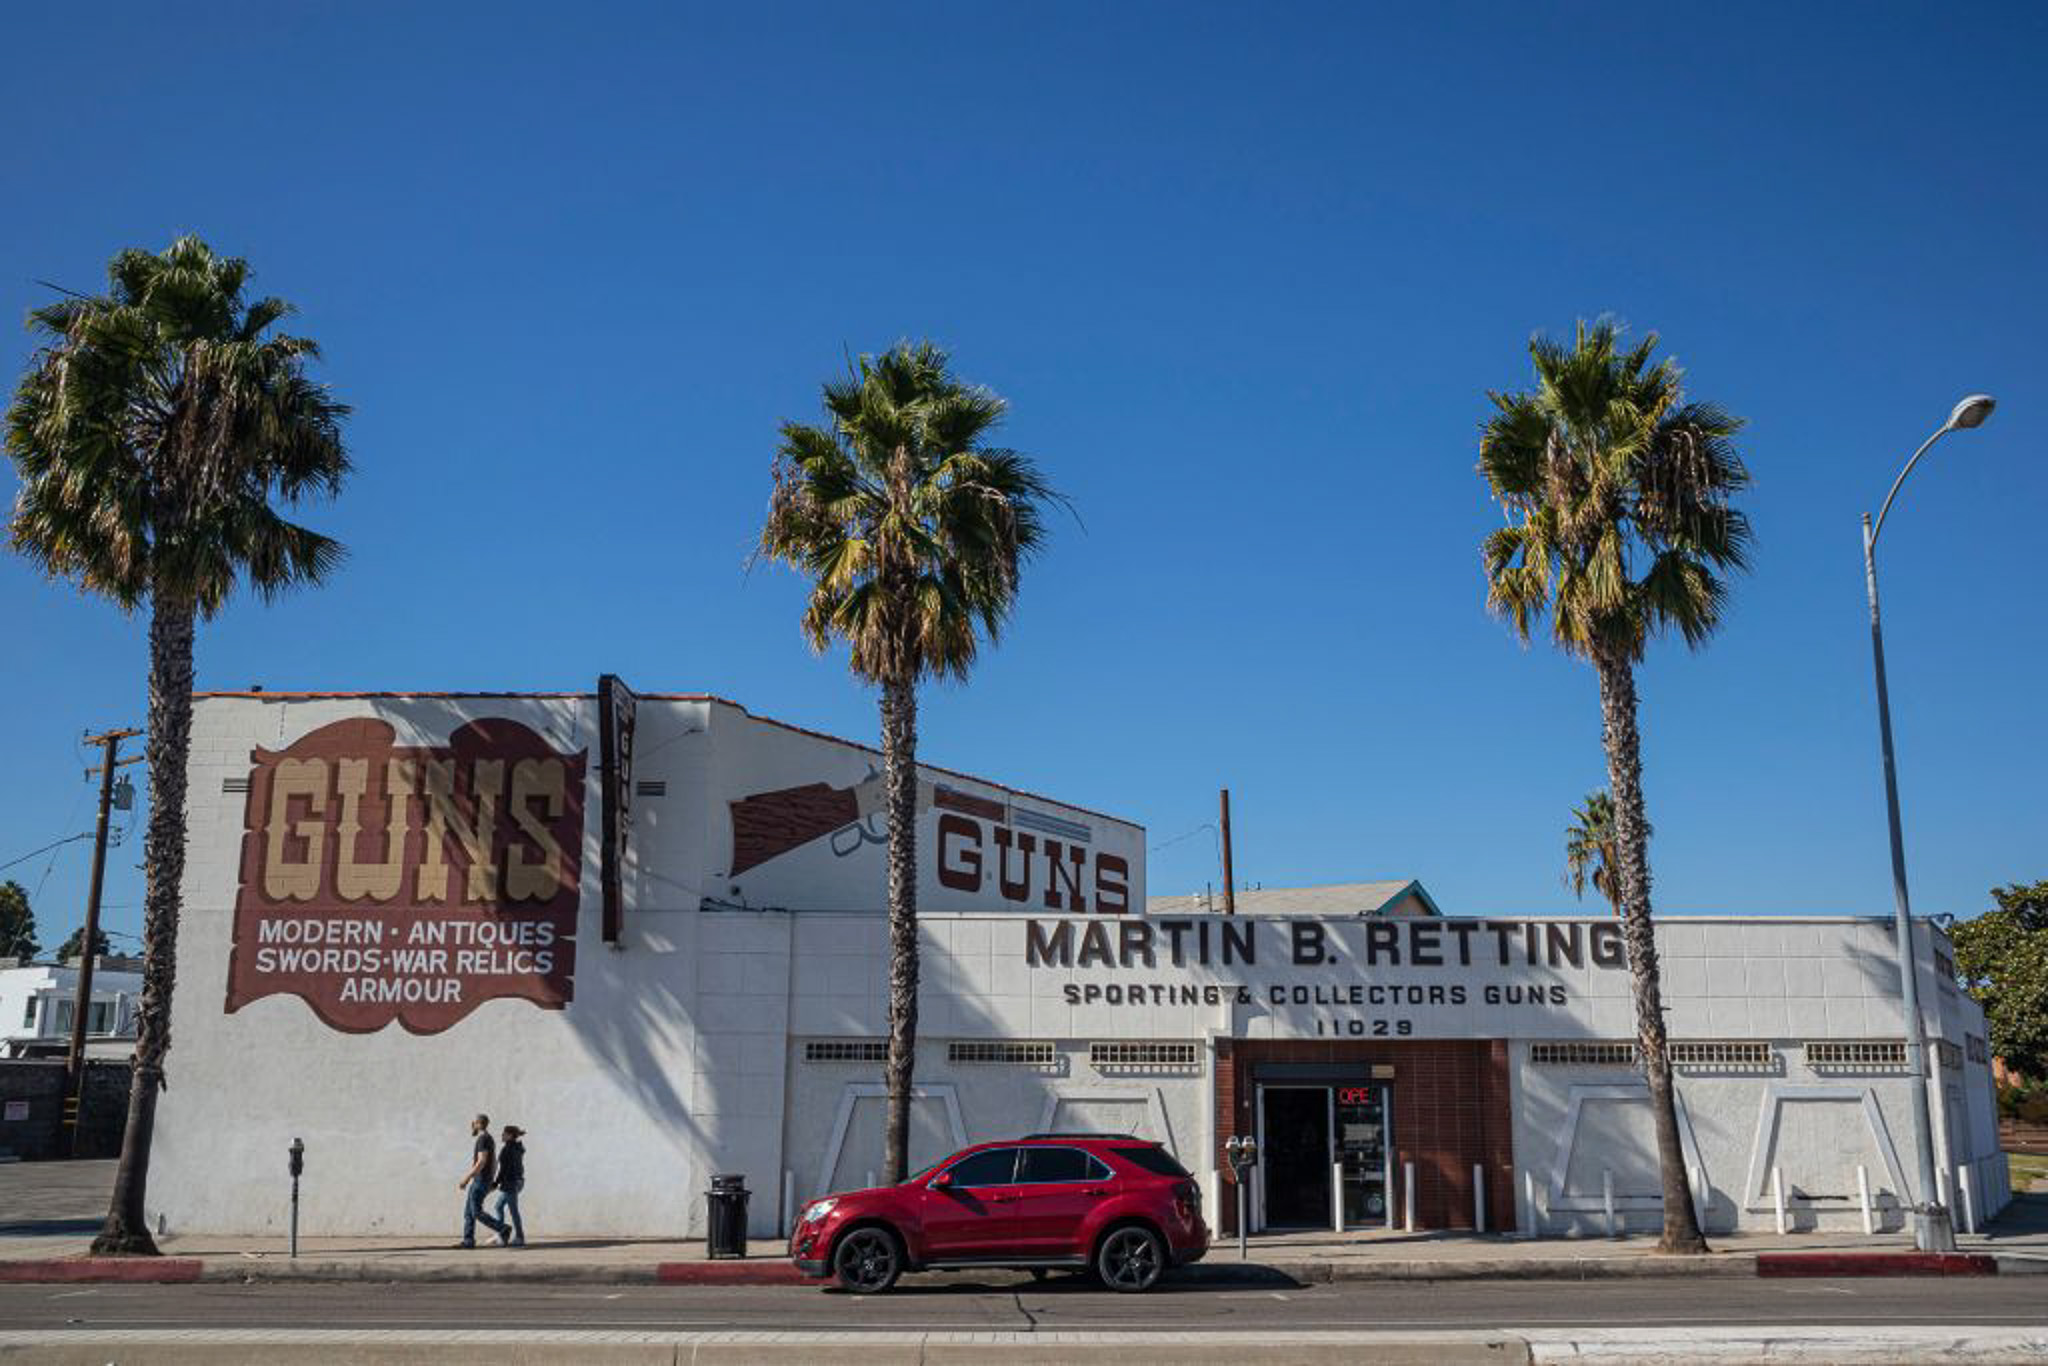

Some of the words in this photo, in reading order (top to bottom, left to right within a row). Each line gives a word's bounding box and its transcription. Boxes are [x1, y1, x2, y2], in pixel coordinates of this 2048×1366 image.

[263, 756, 566, 901] GUNS
[937, 813, 1129, 914] GUNS
[258, 919, 382, 943] MODERN
[407, 920, 556, 948] ANTIQUES
[1025, 919, 1255, 965] MARTIN
[1291, 920, 1337, 965] B.
[1366, 921, 1625, 966] RETTING
[456, 950, 554, 975] RELICS
[339, 977, 462, 1003] ARMOUR
[1063, 983, 1220, 1006] SPORTING
[1236, 984, 1251, 1005] &
[1269, 985, 1467, 1006] COLLECTORS
[1484, 985, 1568, 1006] GUNS
[1317, 1019, 1413, 1036] 11029
[1338, 1087, 1376, 1104] OPE
